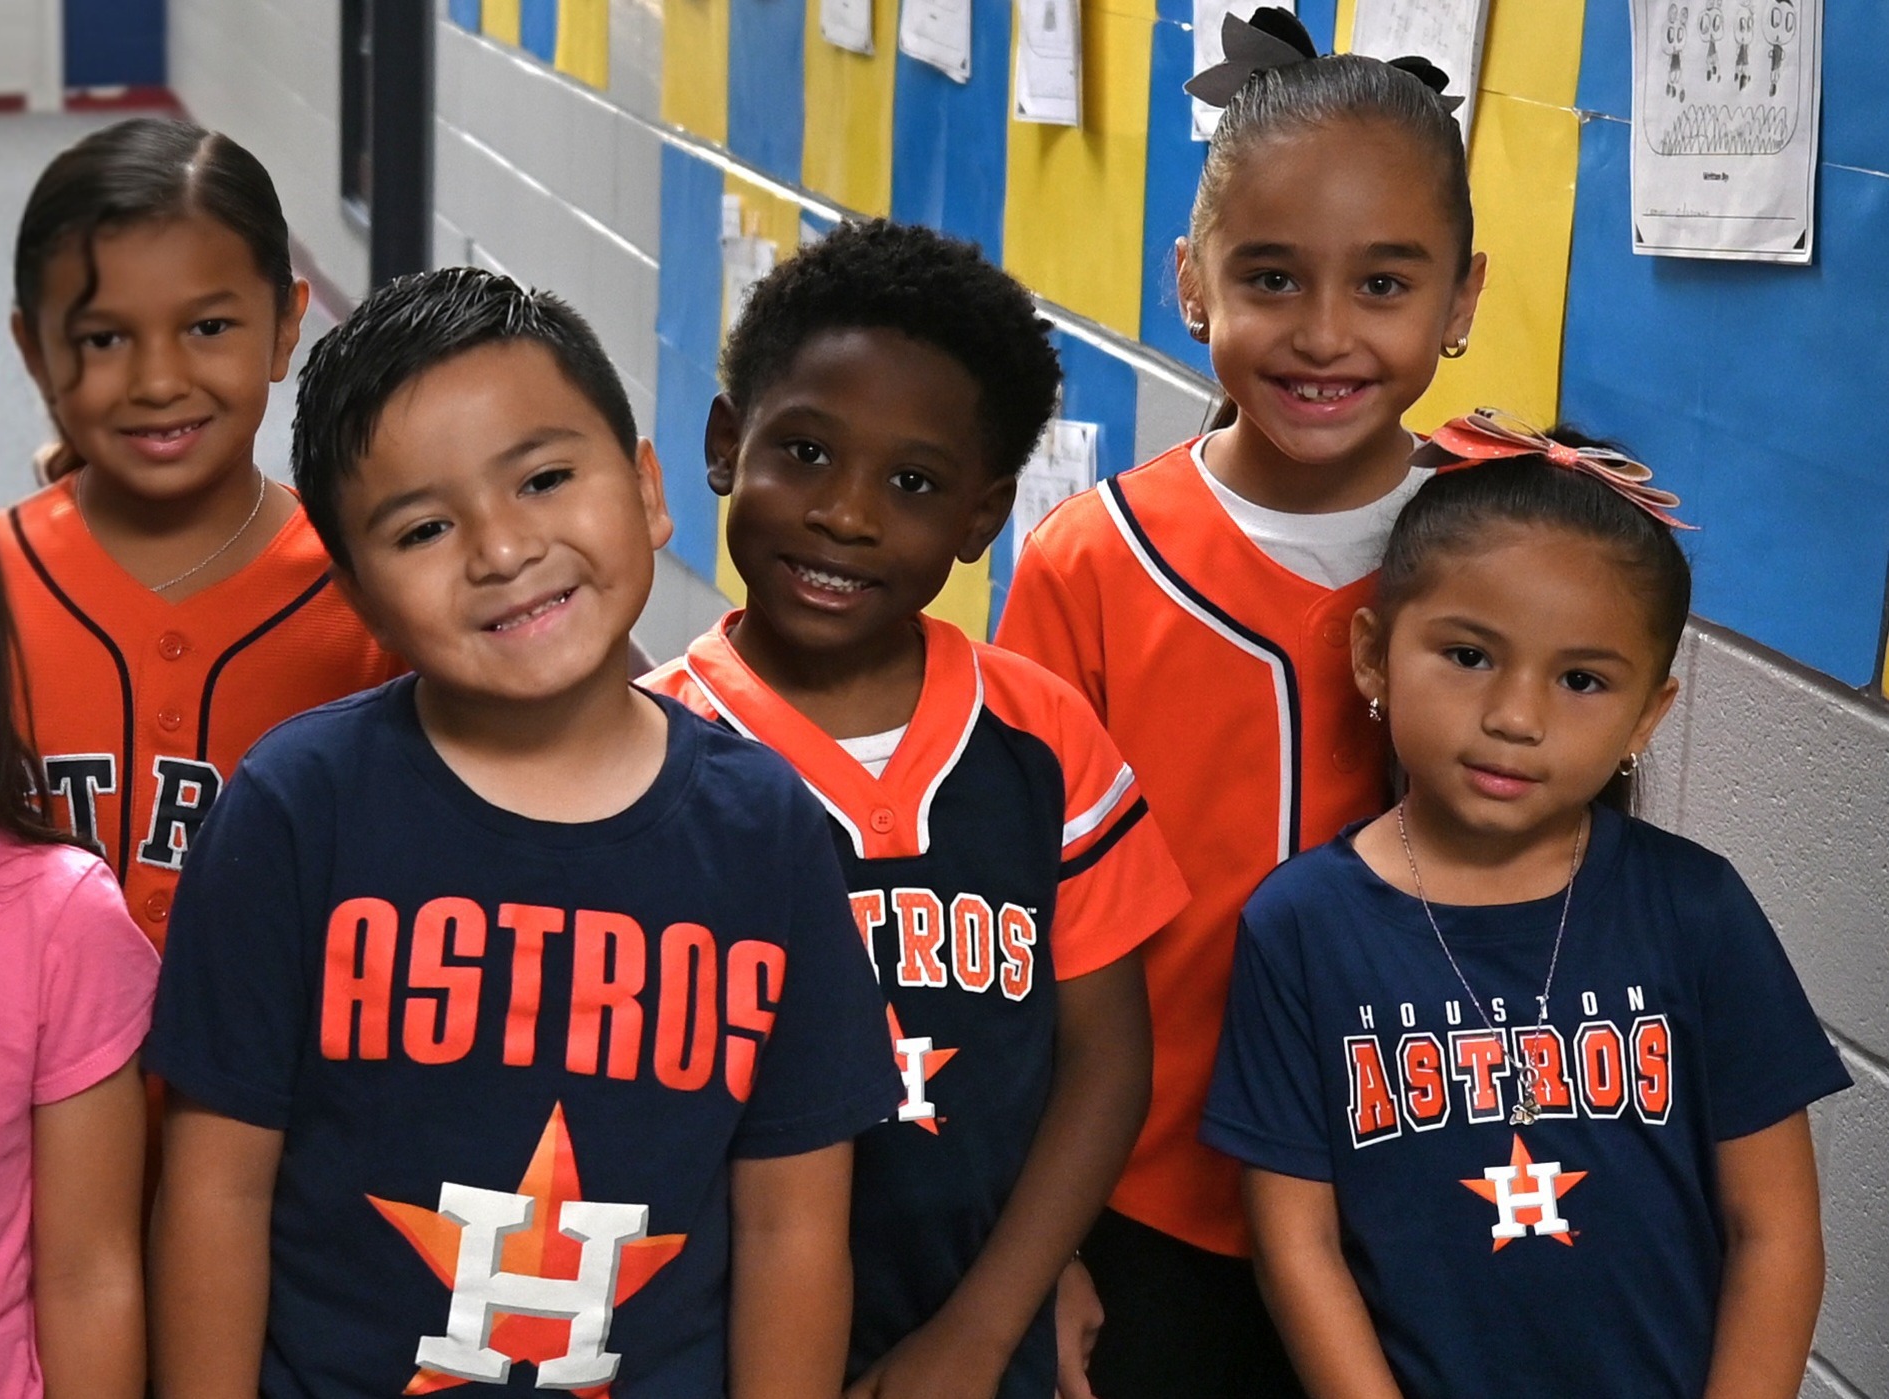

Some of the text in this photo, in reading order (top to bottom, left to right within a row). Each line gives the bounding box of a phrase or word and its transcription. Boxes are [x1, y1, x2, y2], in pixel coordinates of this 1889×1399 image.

[22, 753, 224, 870] TR
[319, 896, 786, 1104] ASTROS
[1359, 986, 1644, 1029] HOUSTON
[1343, 1014, 1672, 1149] ASTROS
[1484, 1161, 1570, 1239] H
[415, 1181, 649, 1388] H
